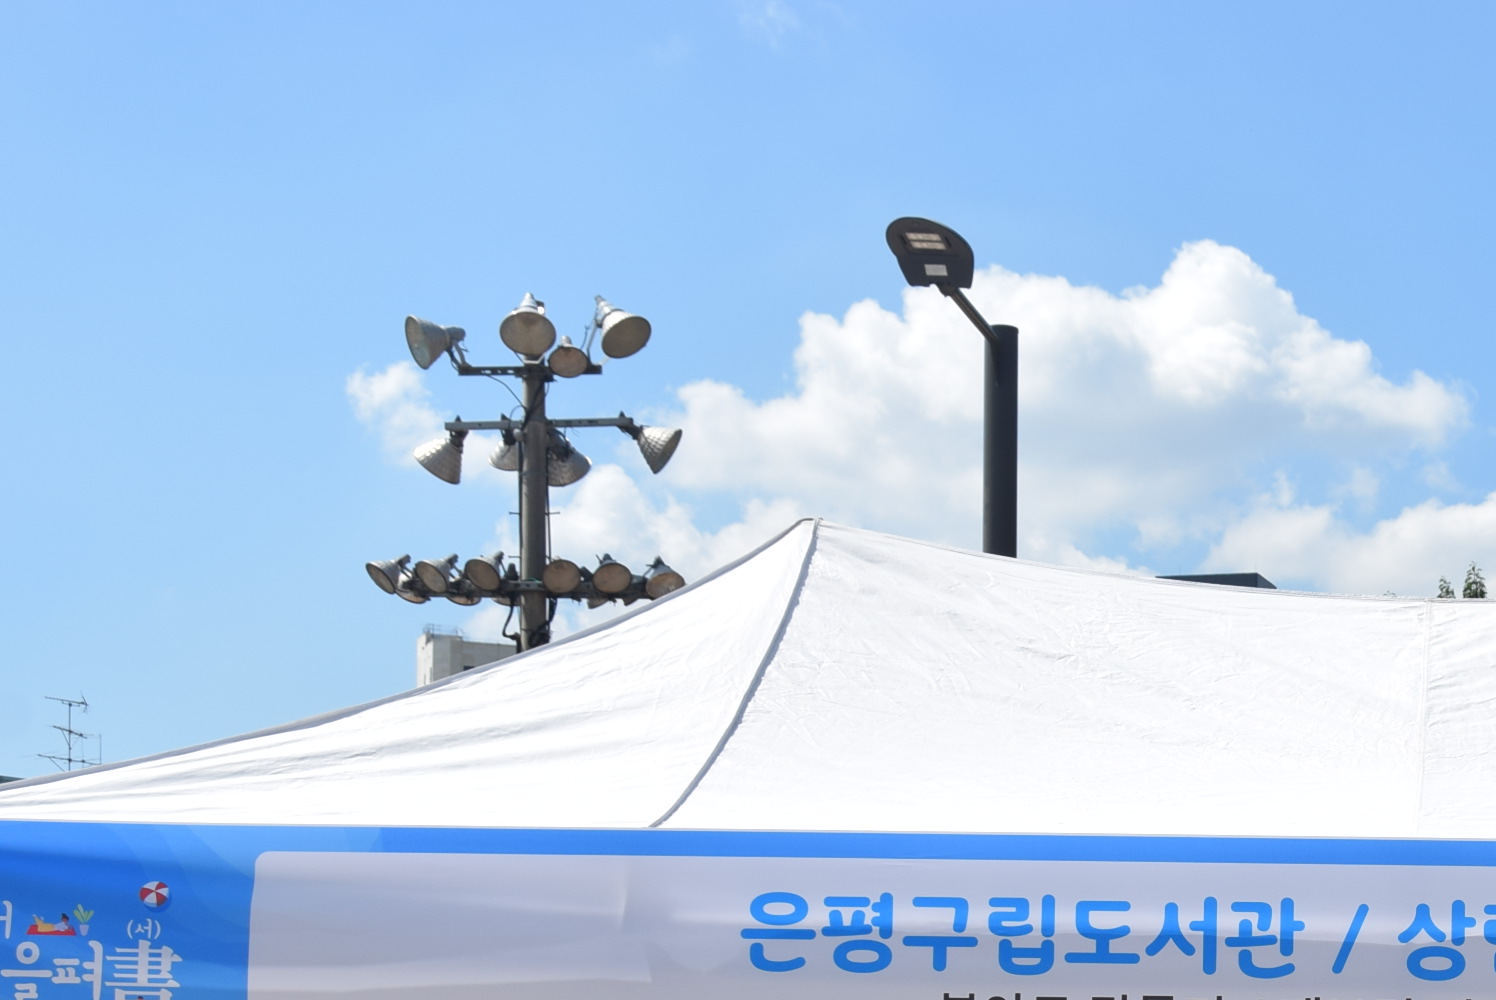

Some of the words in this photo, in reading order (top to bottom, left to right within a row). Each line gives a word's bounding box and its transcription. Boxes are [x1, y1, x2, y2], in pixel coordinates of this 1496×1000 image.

[127, 918, 162, 940] (서)
[740, 891, 1305, 980] 은평구립도서관
[1331, 903, 1369, 975] /
